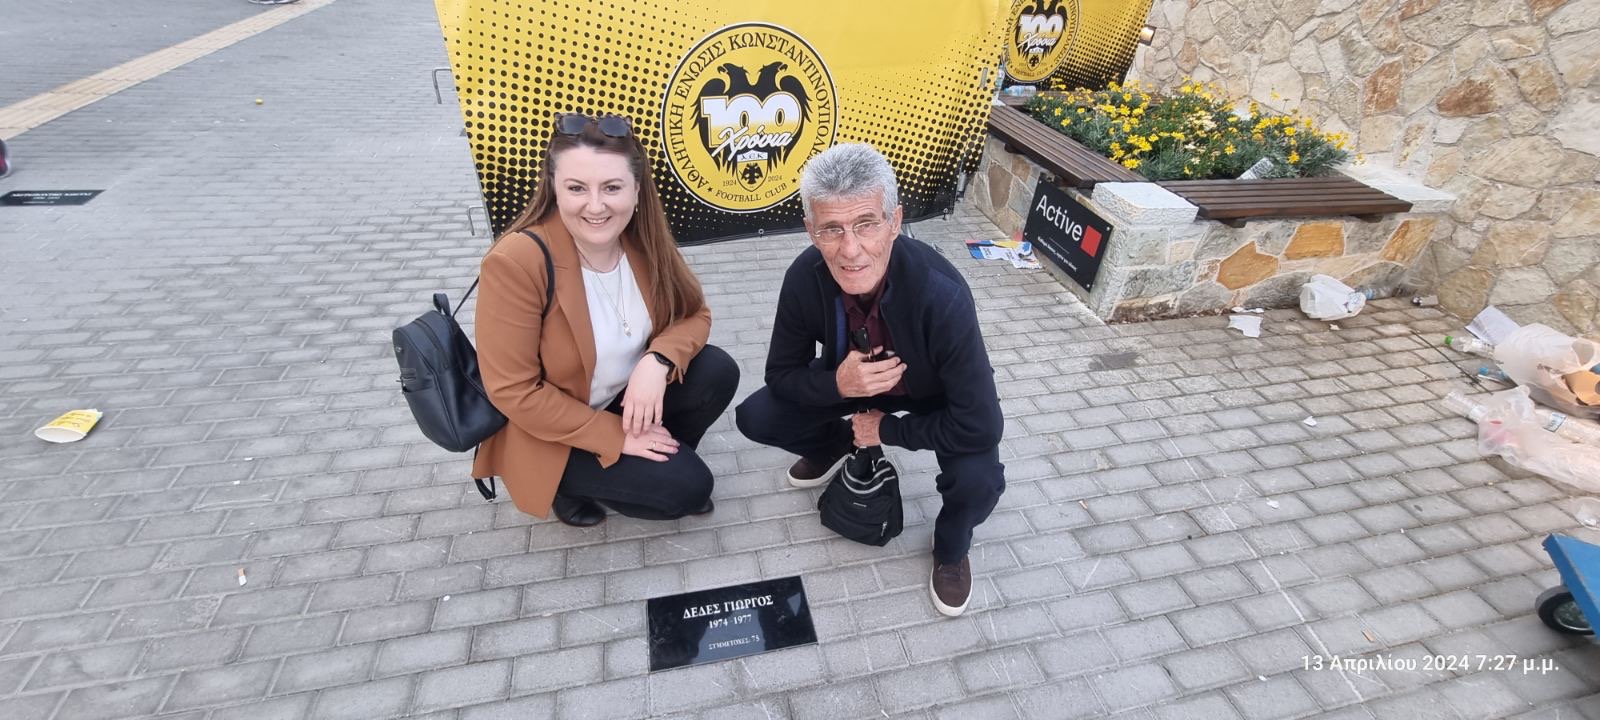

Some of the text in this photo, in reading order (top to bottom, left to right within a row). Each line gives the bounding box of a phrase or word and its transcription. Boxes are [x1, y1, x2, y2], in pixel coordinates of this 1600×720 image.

[1018, 13, 1064, 43] 100
[669, 31, 830, 190] ΑΘΛΗΤΙΚΗ ΕΝΩΣΙΣ ΚΩΝΣΤΑΝΤΙΝΟΥΠΟΛΕ
[700, 91, 802, 148] 100
[711, 125, 794, 162] Χρόνια
[715, 182, 788, 203] FOOTBALL CLUB
[1035, 194, 1083, 242] Active
[682, 594, 774, 619] ΔΕΔΕΣ ΓΙΩΡΓΟΣ
[708, 618, 728, 629] 1974
[733, 614, 752, 625] 1977
